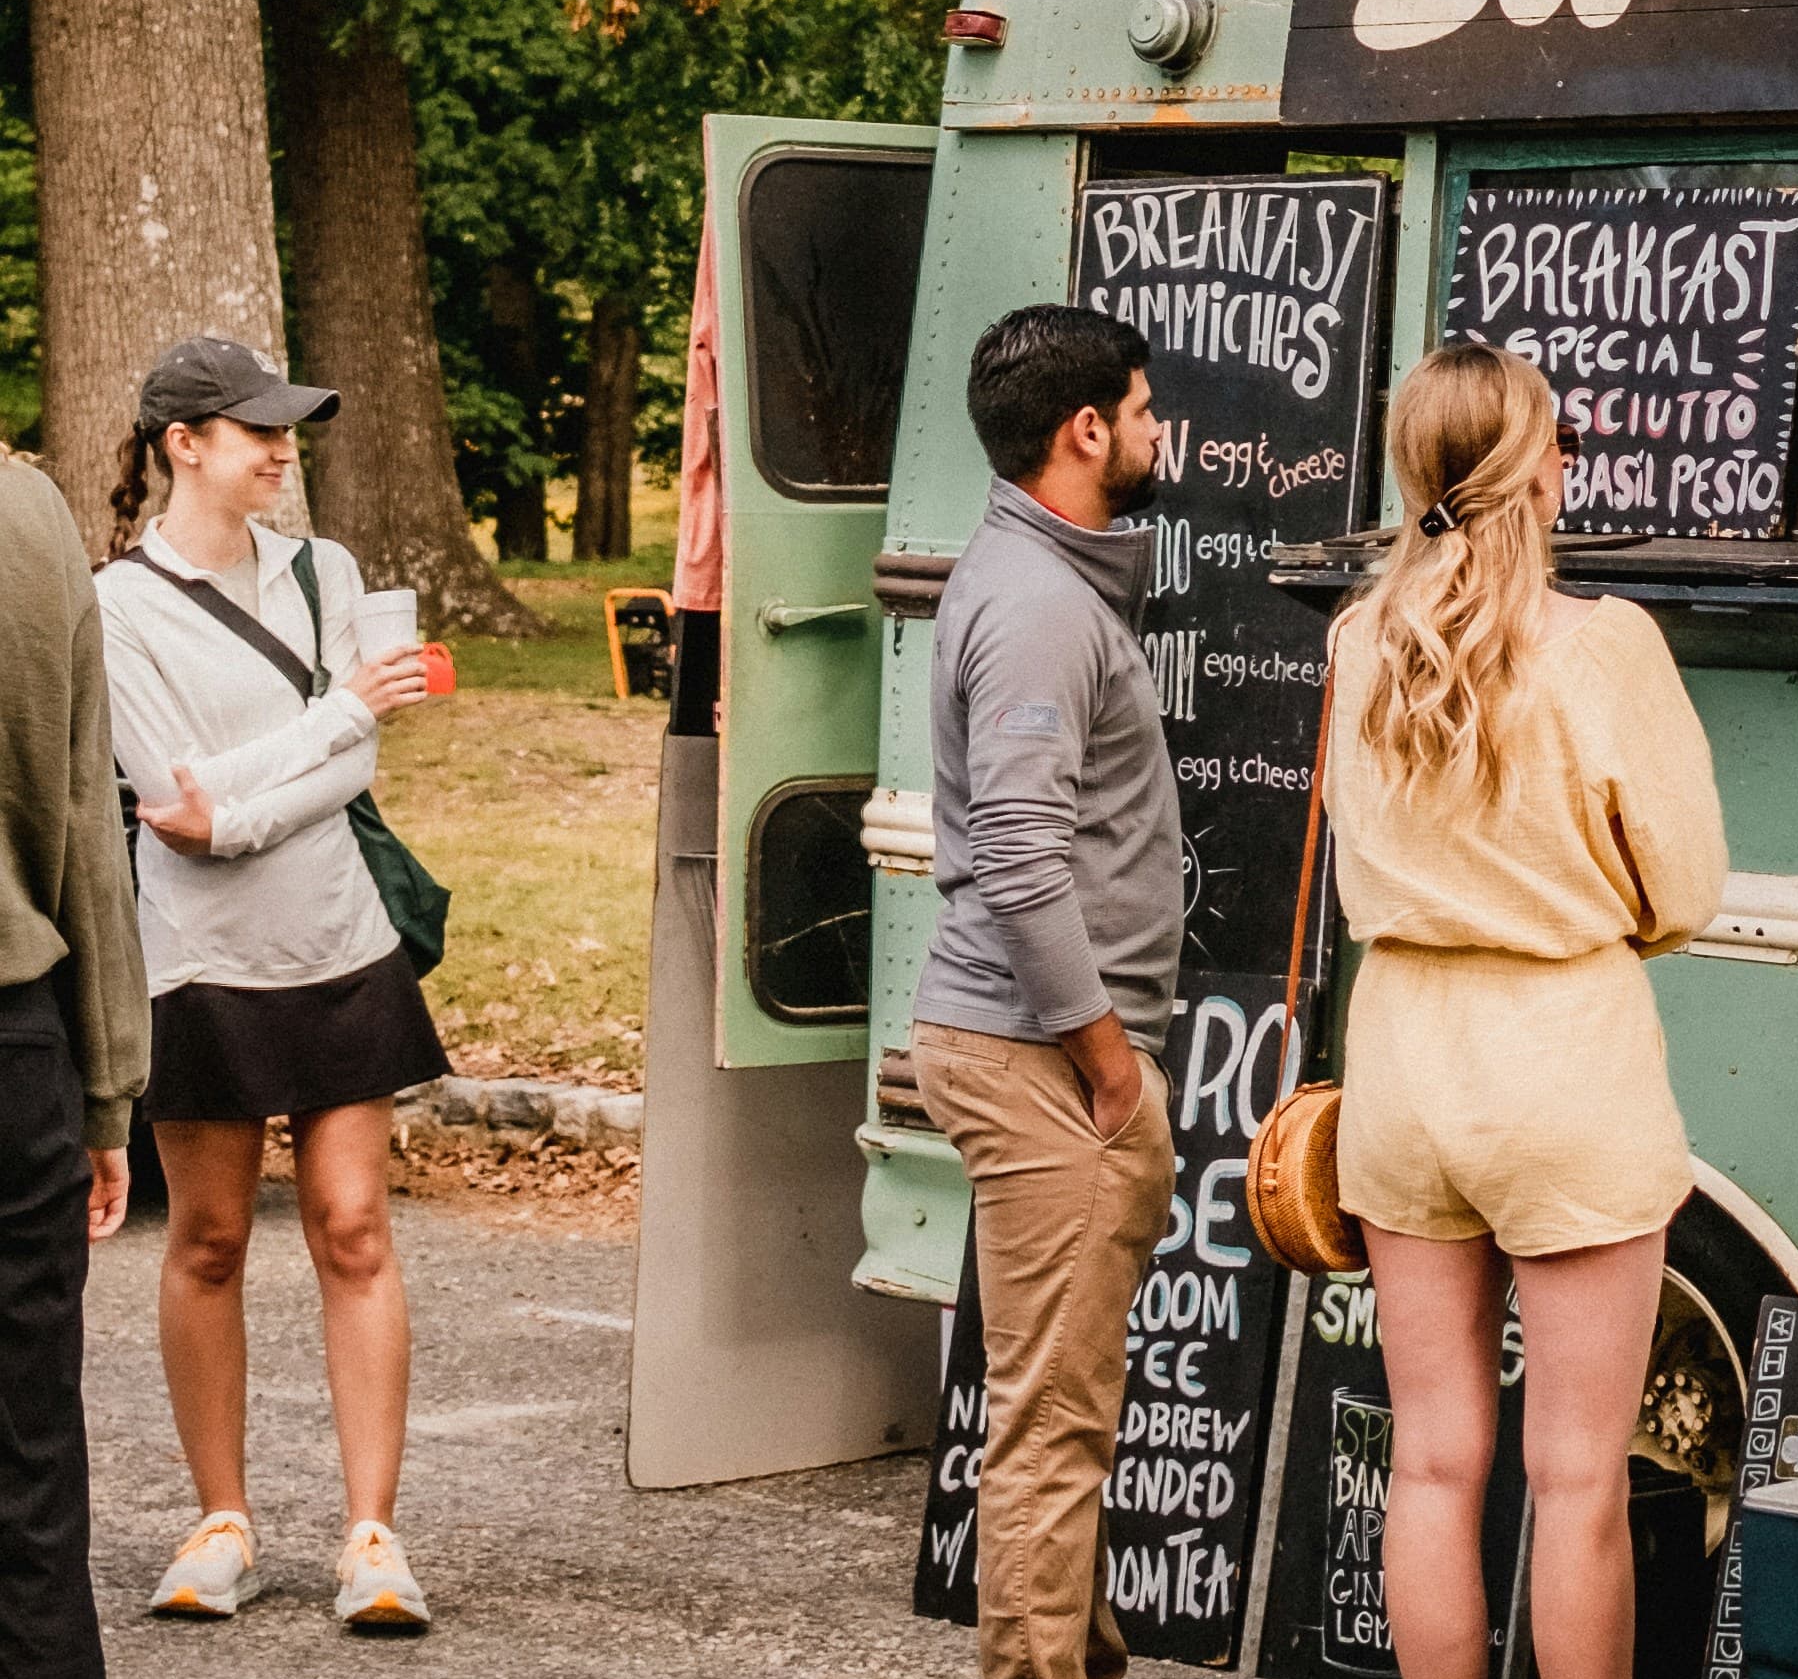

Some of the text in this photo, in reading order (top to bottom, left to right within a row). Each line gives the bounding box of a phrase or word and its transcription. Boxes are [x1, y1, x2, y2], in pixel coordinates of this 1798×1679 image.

[1093, 190, 1374, 307] BREAKFAST
[1505, 325, 1714, 378] SPECIAL
[1200, 440, 1252, 489] egg
[1268, 447, 1346, 498] cheese
[1196, 533, 1241, 568] egg
[1204, 653, 1246, 687] egg
[1178, 756, 1221, 791] egg
[1242, 753, 1316, 791] chees
[1102, 1454, 1235, 1519] LENDED
[1166, 1527, 1235, 1620] TEA
